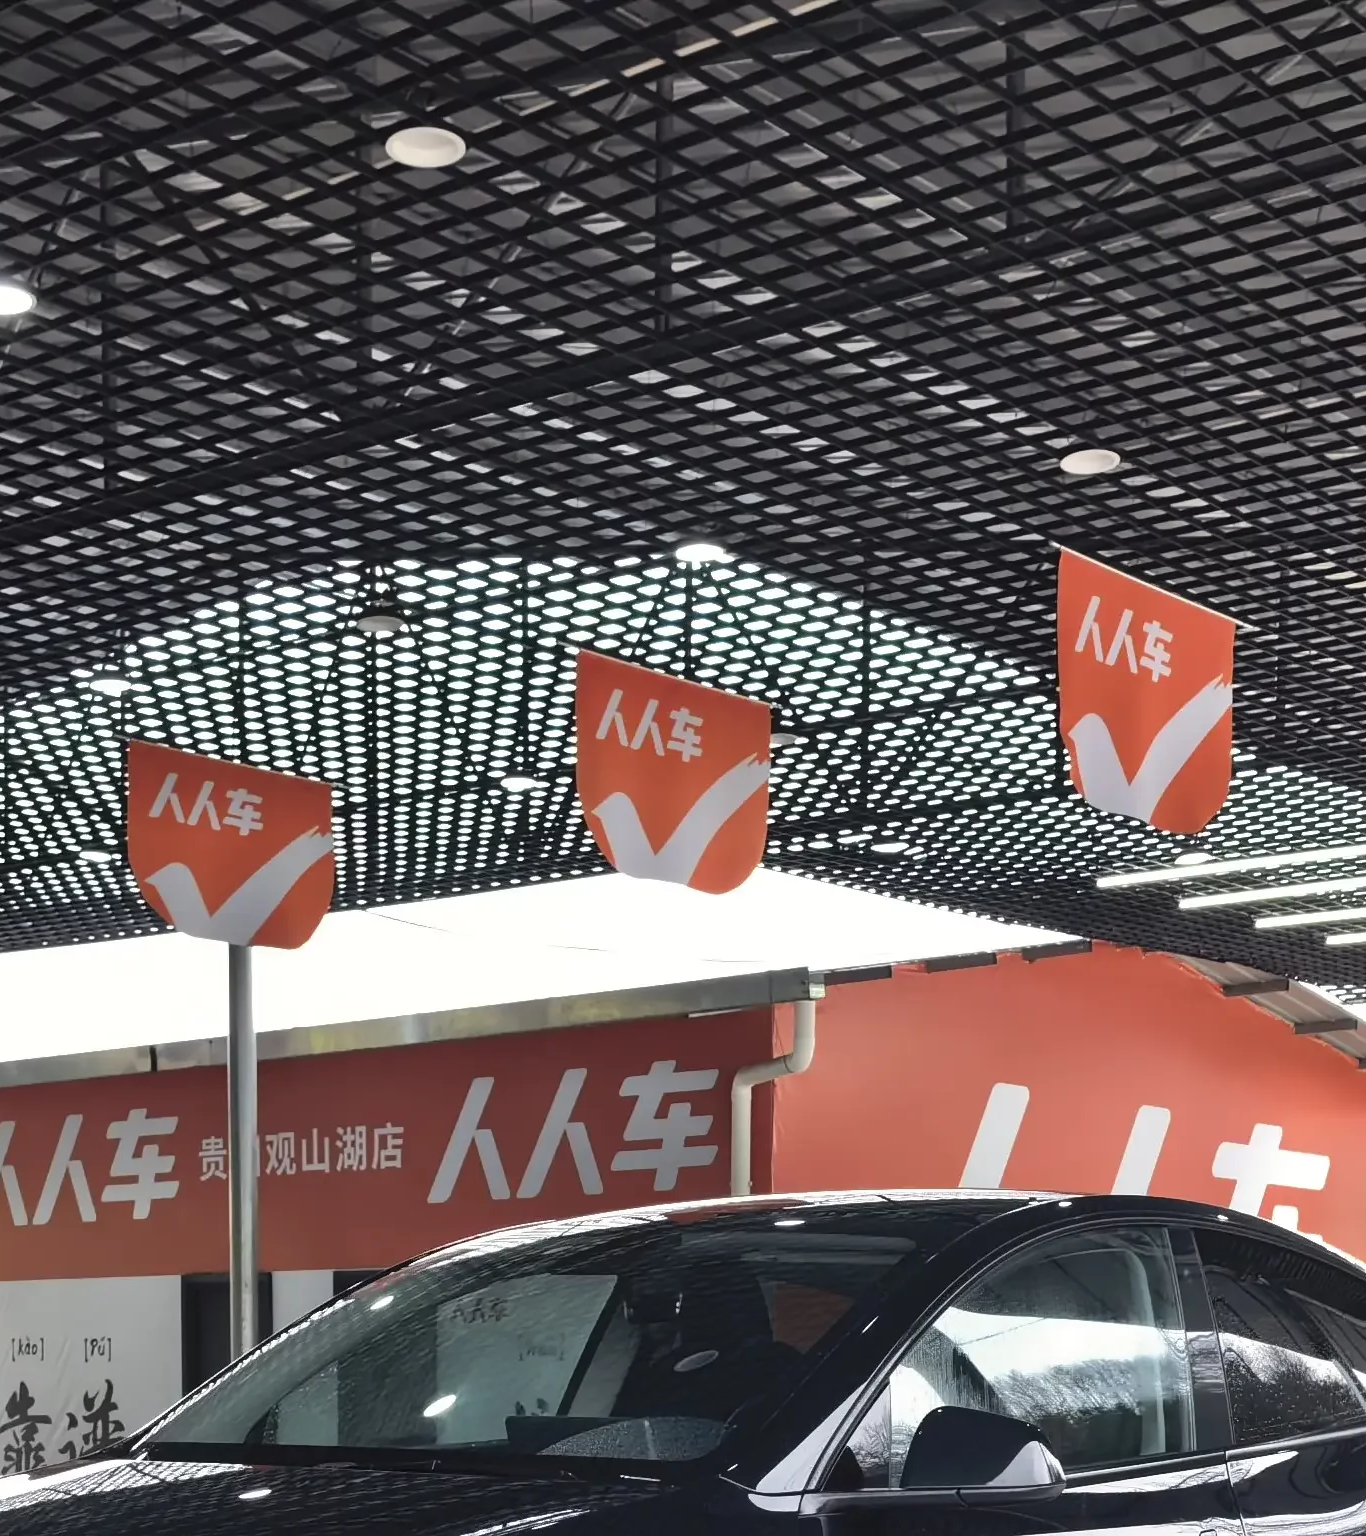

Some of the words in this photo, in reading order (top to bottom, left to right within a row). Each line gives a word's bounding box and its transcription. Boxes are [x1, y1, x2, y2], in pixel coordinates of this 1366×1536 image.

[1074, 595, 1172, 684] 人人车
[596, 688, 704, 763] 人人车
[147, 773, 264, 836] 人人车
[198, 1122, 404, 1182] 贵观山湖店
[427, 1060, 719, 1204] 人人车
